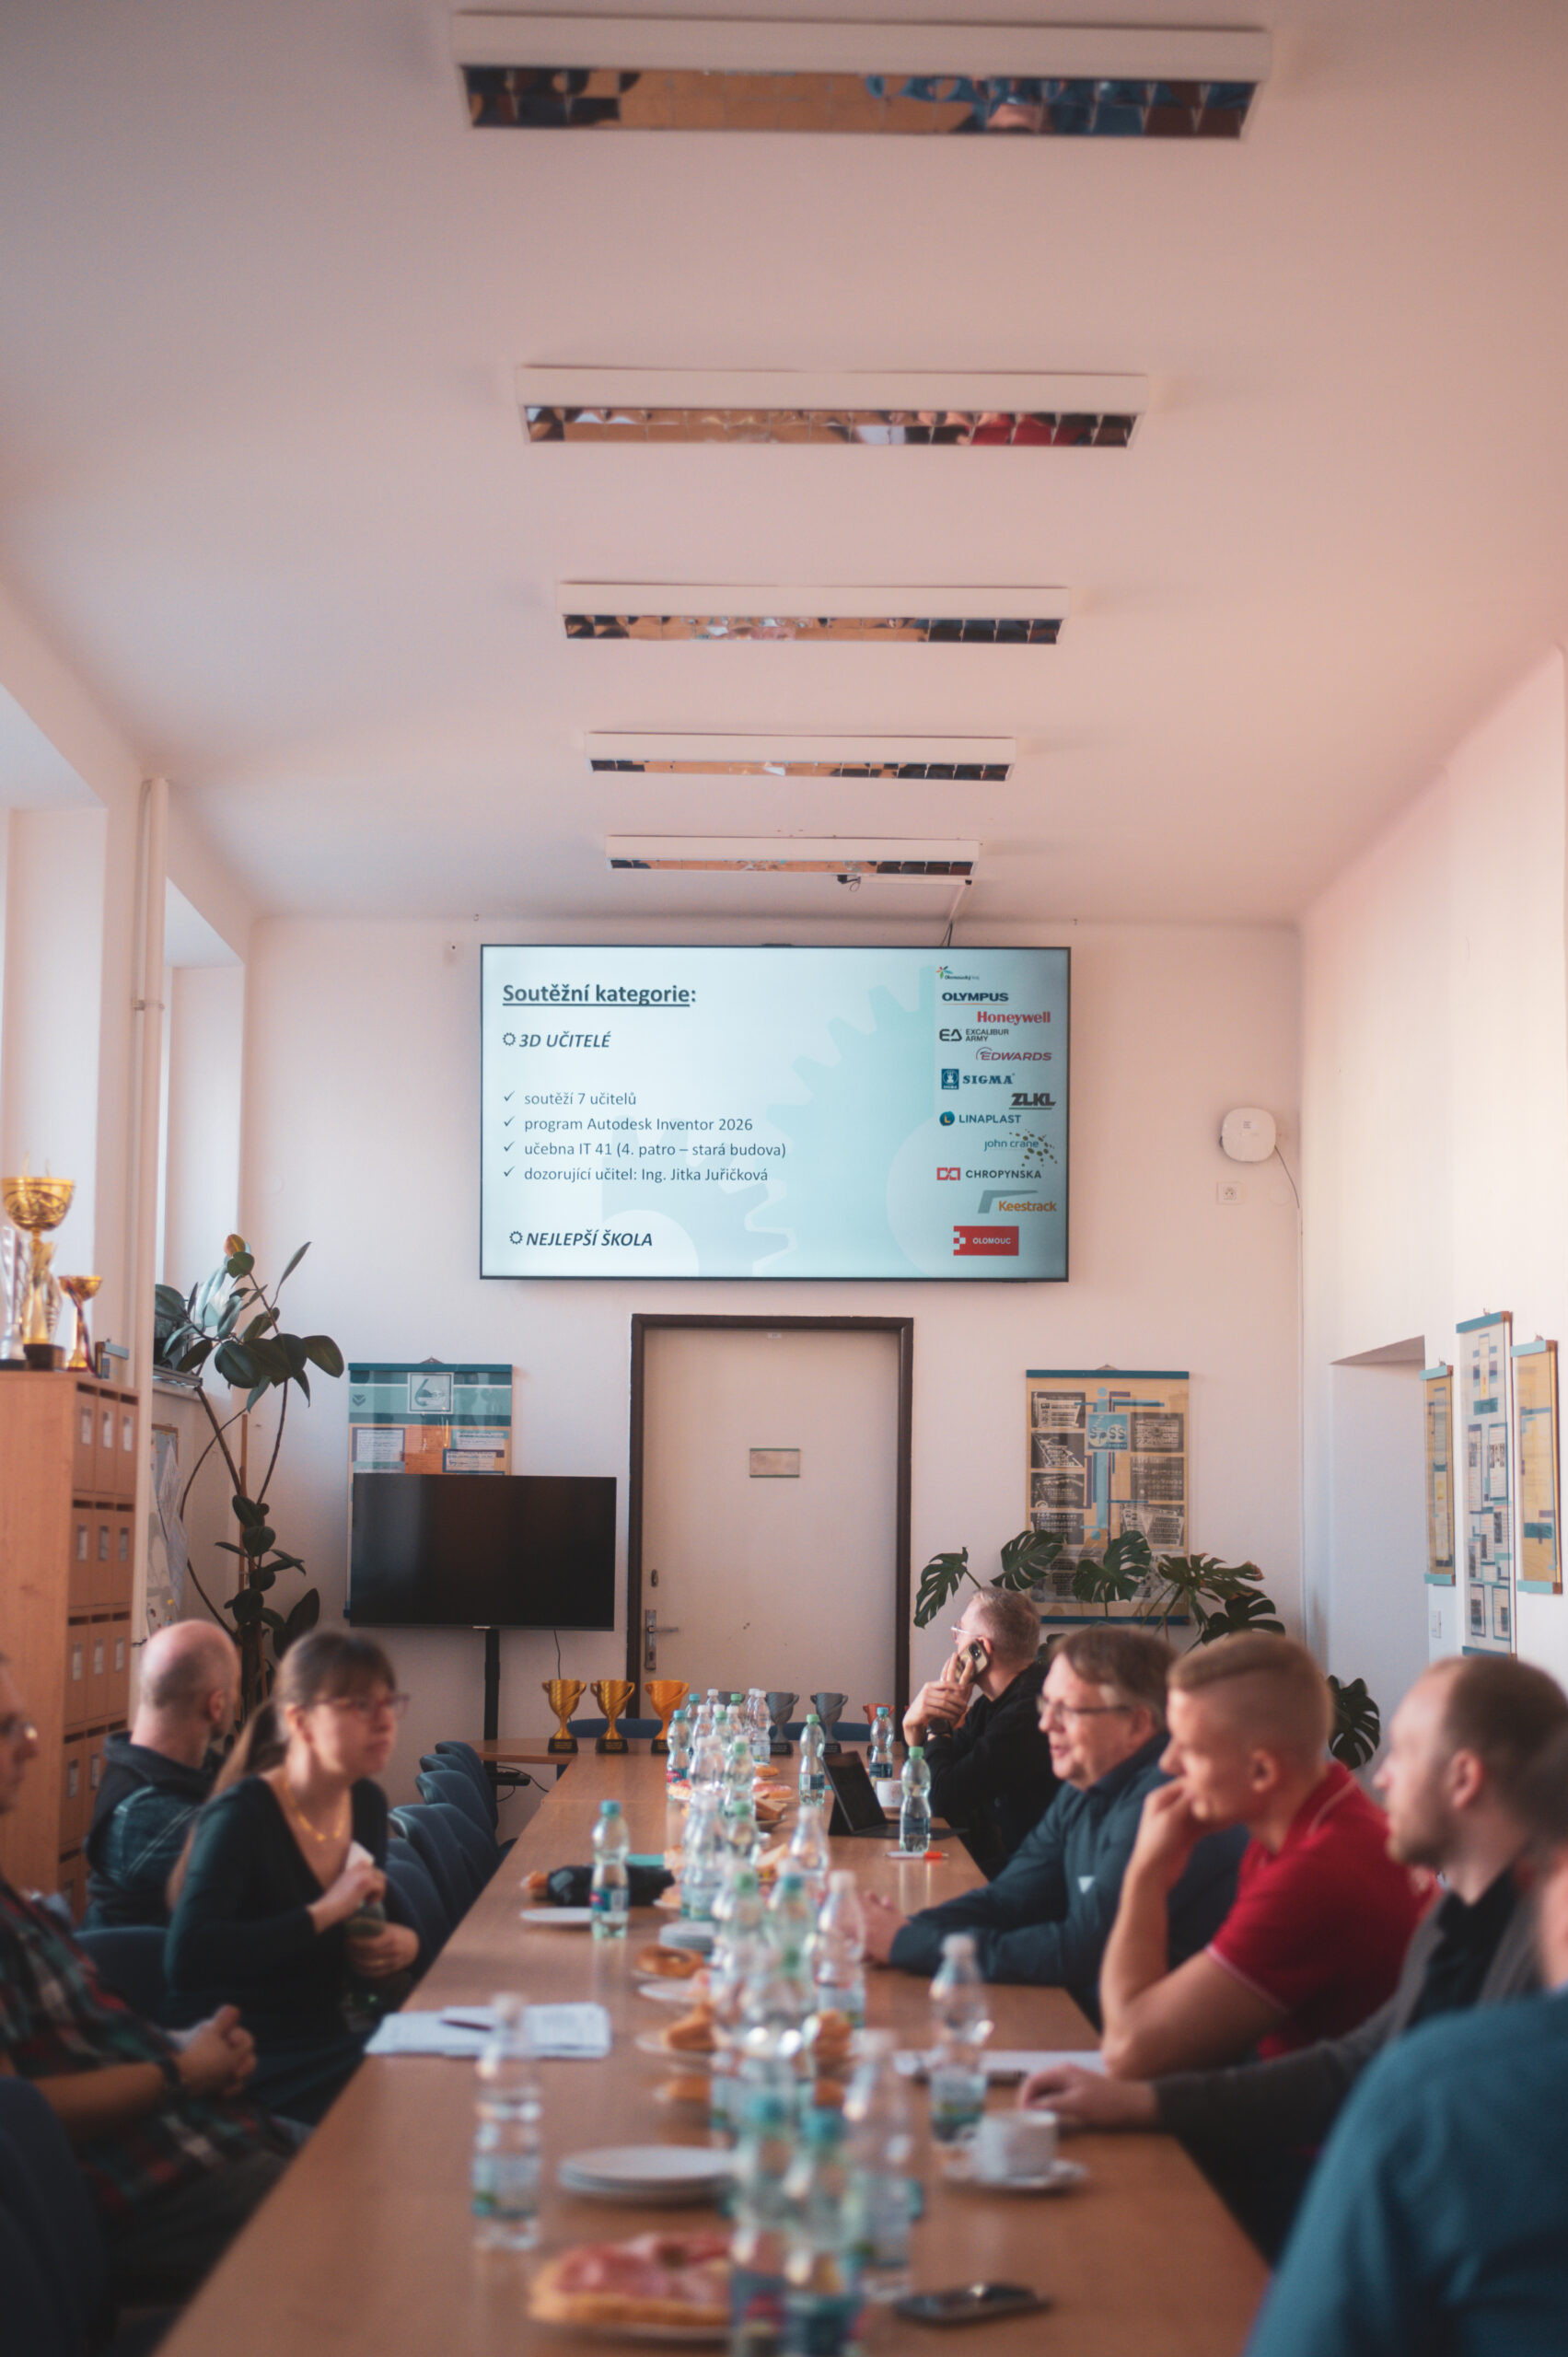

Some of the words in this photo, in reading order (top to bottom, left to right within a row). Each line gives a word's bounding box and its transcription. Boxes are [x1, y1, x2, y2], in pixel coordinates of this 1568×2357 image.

[503, 983, 590, 1002] Soutěžní
[596, 983, 696, 1006] kategorie:
[942, 993, 1009, 1002] OLYMPUS
[977, 1011, 1051, 1026] Honeywell
[518, 1033, 541, 1047] 3D
[546, 1030, 611, 1047] UČITELÉ
[981, 1051, 1052, 1061] EDWARDS
[963, 1075, 1013, 1084] SIGMA
[524, 1092, 574, 1105] soutěží
[577, 1092, 586, 1104] 7
[589, 1092, 636, 1105] učitelů
[1012, 1093, 1056, 1106] ZLKL
[524, 1120, 583, 1132] program
[587, 1117, 653, 1130] Autodesk
[656, 1118, 714, 1130] Inventor
[718, 1118, 753, 1131] 2026
[959, 1115, 1021, 1123] LINAPLAST
[524, 1142, 575, 1155] učebna
[579, 1143, 592, 1155] IT
[595, 1143, 612, 1155] 41
[616, 1142, 634, 1157] (4.
[638, 1144, 676, 1157] patro
[691, 1143, 726, 1155] stará
[729, 1143, 786, 1158] budova)
[984, 1139, 1007, 1151] john
[1010, 1140, 1039, 1148] crane
[524, 1167, 591, 1182] dozorující
[595, 1167, 637, 1179] učitel:
[642, 1167, 667, 1183] Ing.
[670, 1167, 702, 1180] Jitka
[704, 1167, 768, 1180] Juřičková
[998, 1201, 1057, 1212] Keestrack
[526, 1229, 599, 1246] NEJLEPŠÍ
[600, 1229, 653, 1246] ŠKOLA
